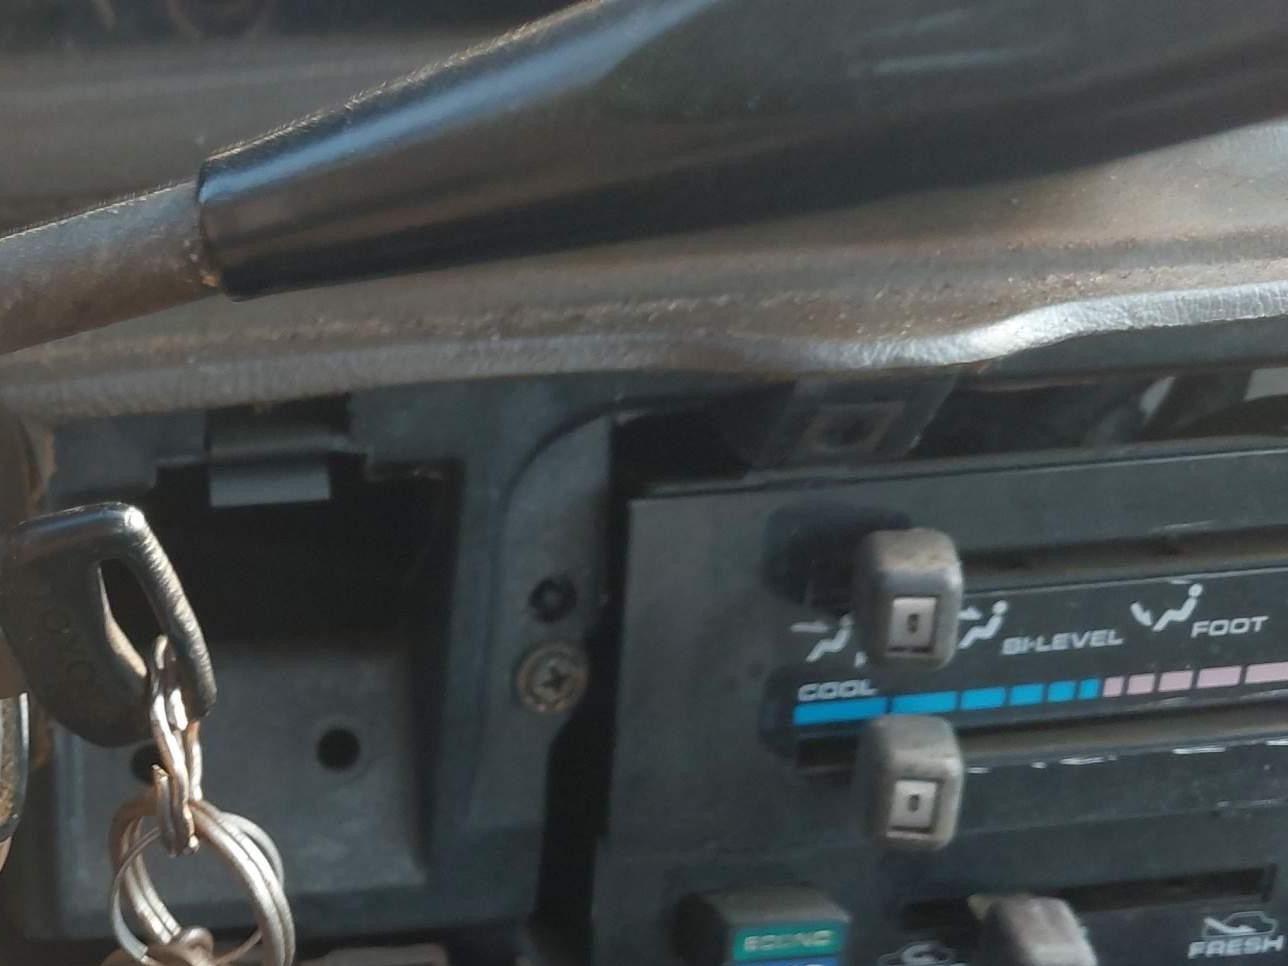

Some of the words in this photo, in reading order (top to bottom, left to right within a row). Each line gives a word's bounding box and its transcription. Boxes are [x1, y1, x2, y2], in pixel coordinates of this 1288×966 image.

[1190, 615, 1269, 638] FOOT
[1001, 628, 1124, 656] BI-LEVEL
[797, 678, 878, 702] COOL
[1188, 934, 1284, 959] FRESH
